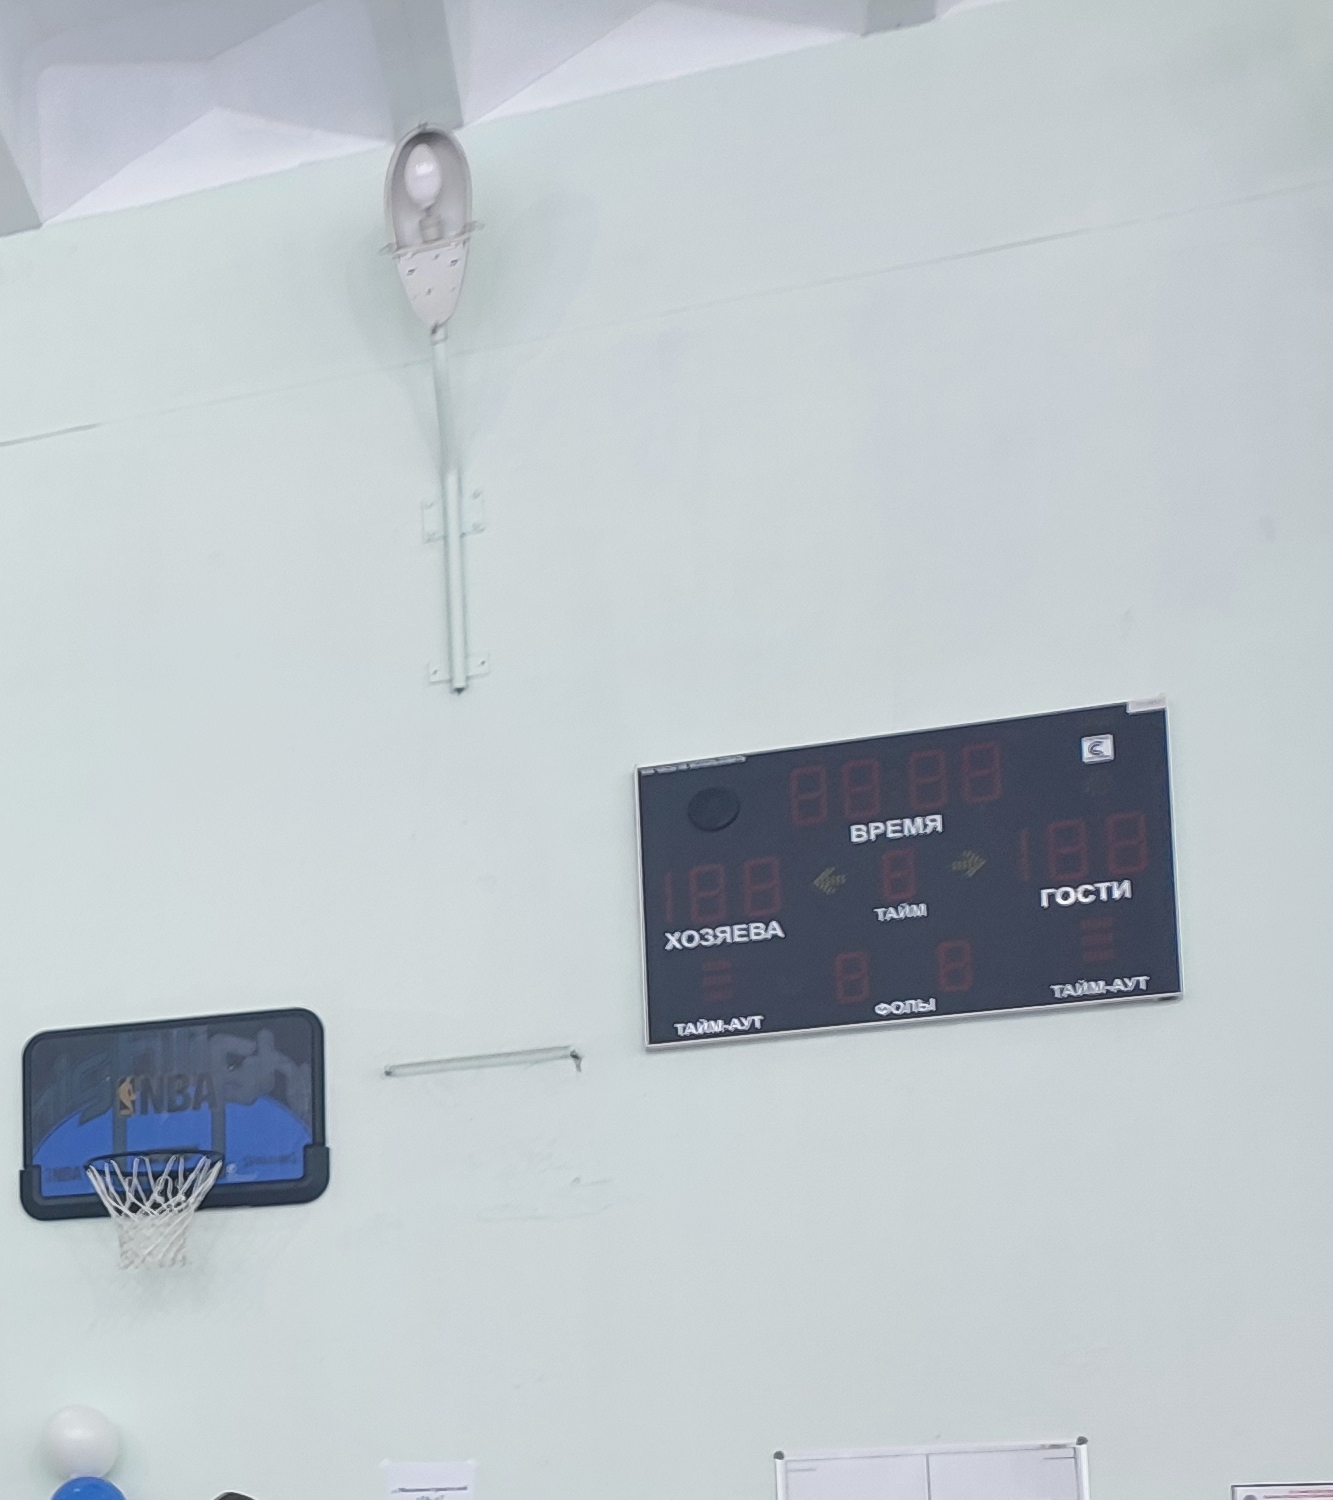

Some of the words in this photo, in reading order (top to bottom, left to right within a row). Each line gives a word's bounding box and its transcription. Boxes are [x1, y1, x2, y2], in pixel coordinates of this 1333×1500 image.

[849, 813, 943, 844] ВРЕМЯ
[1040, 879, 1132, 909] ГОСТИ
[873, 902, 928, 922] ТАЙМ
[664, 920, 785, 950] ХОЗЯЕВА
[1050, 975, 1151, 999] ТАЙМ-АУТ
[674, 1014, 765, 1037] ТАЙМ-АУТ
[140, 1072, 218, 1115] NBA
